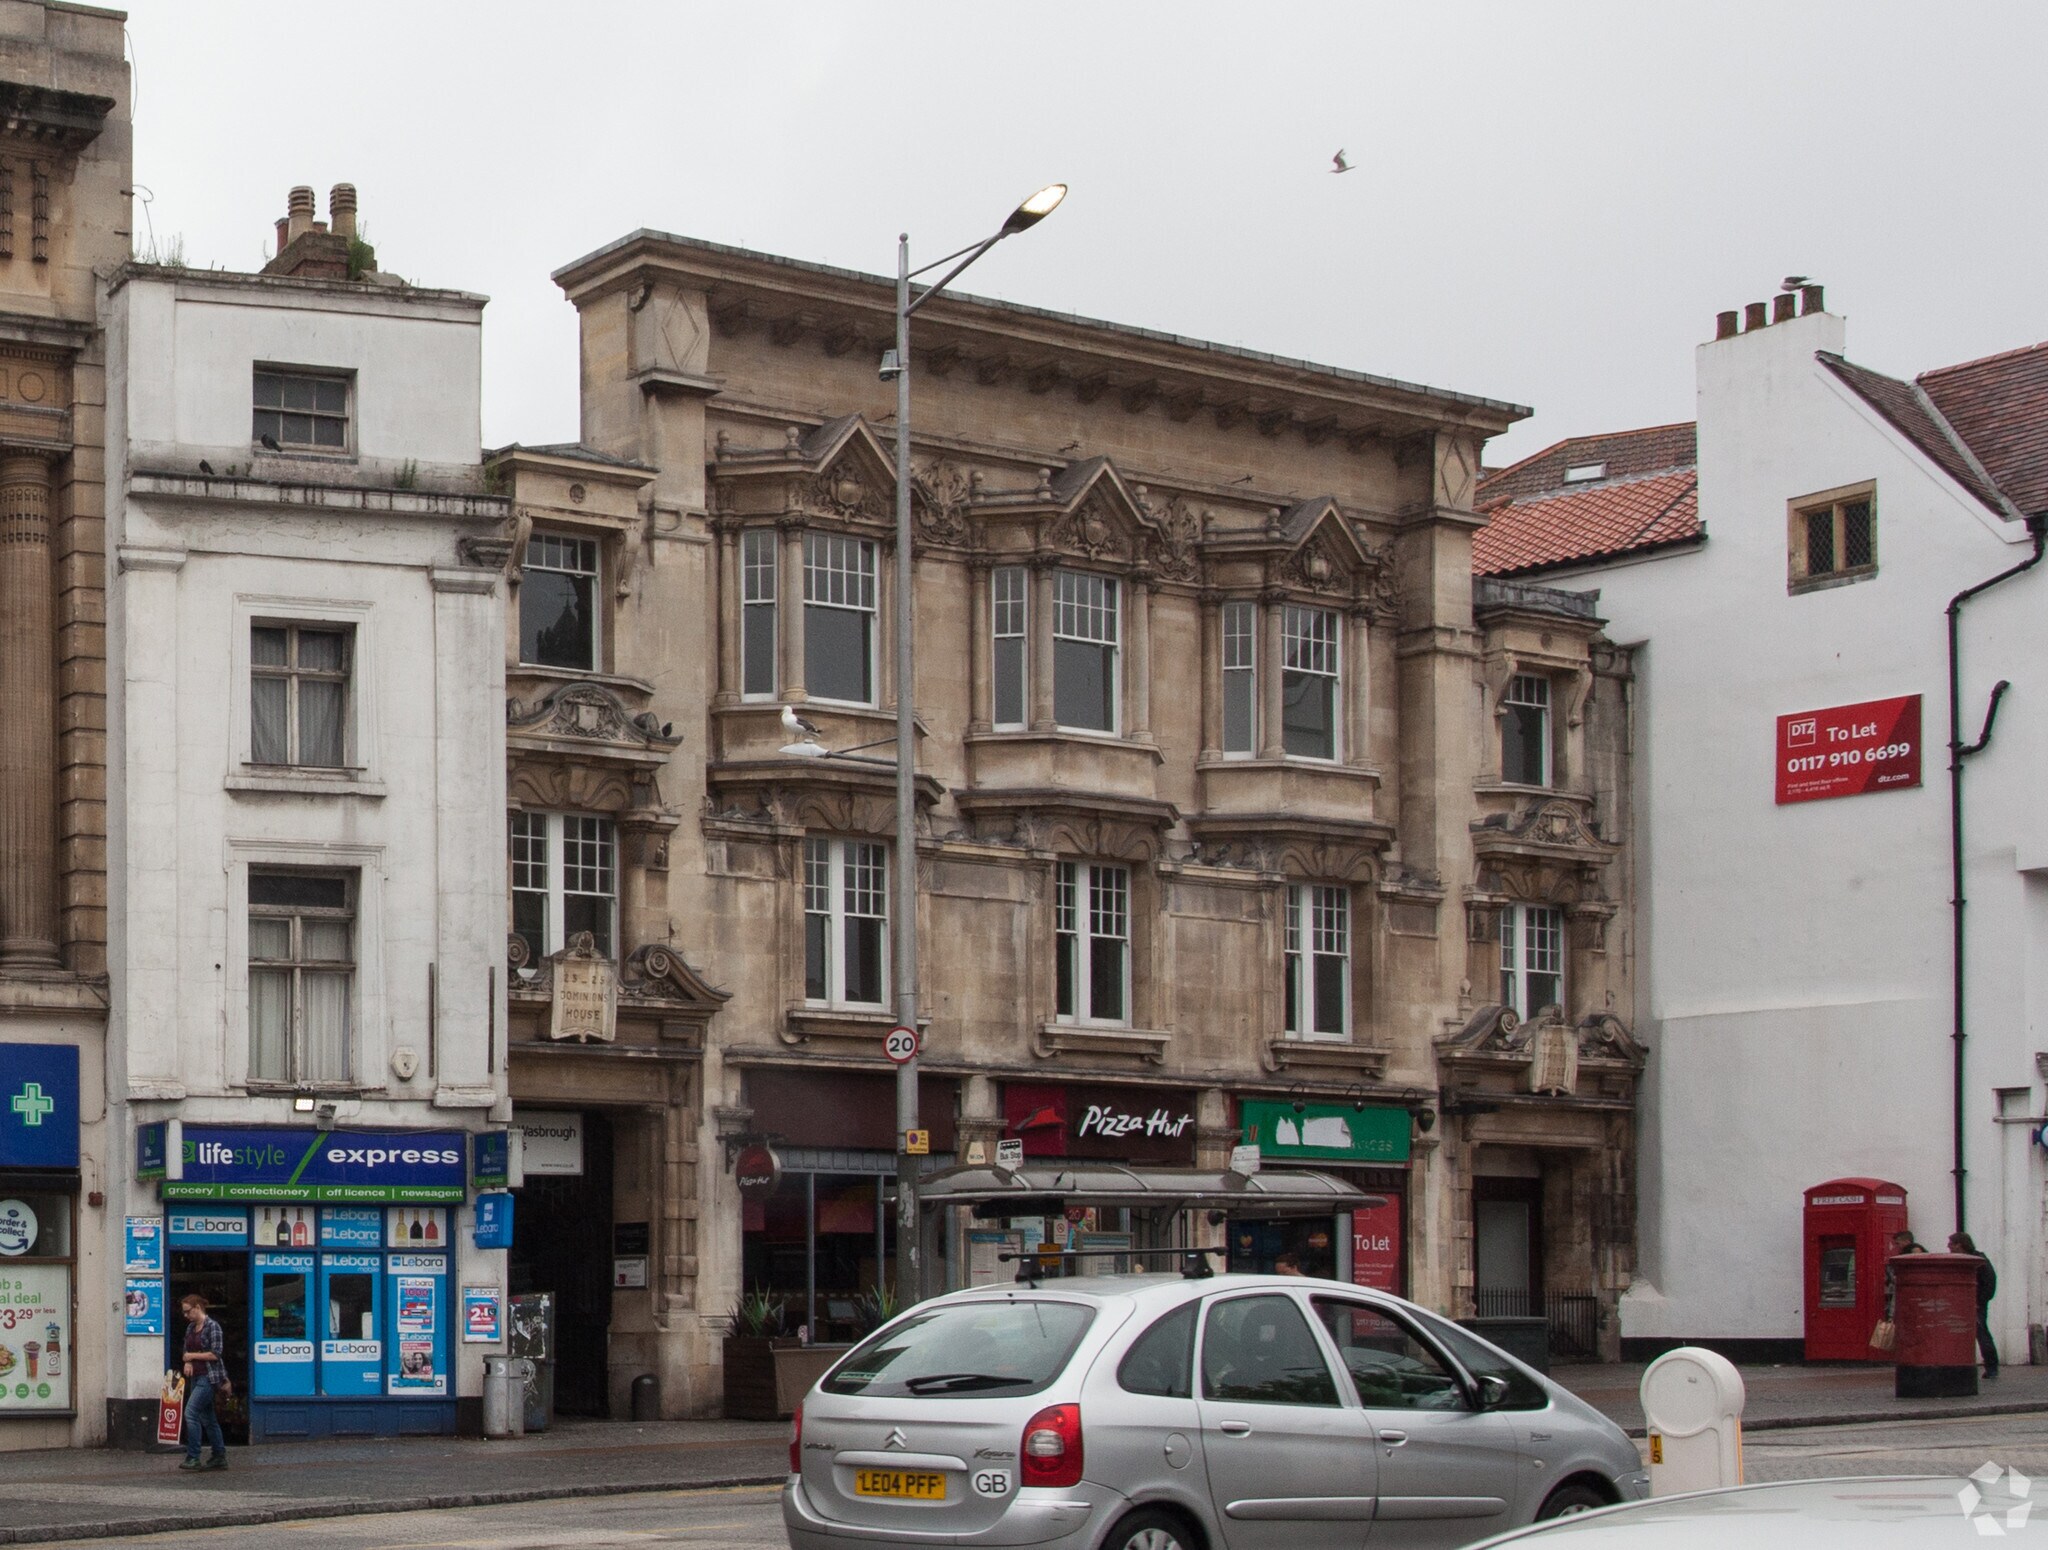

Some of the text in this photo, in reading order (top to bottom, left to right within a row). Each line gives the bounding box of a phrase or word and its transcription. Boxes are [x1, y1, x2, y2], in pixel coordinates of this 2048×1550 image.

[1792, 722, 1877, 742] DTZ To Let
[1787, 743, 1910, 772] 0117 910 6699
[1878, 774, 1909, 784] dtz.com
[566, 1008, 600, 1020] HOUSE
[890, 1037, 914, 1052] 20
[1080, 1105, 1194, 1137] Pizza Hut
[199, 1142, 460, 1169] lifestyle express
[168, 1187, 463, 1198] grocery confectionery off licence newsagent
[333, 1208, 379, 1220] Lebara
[187, 1218, 242, 1232] Lebara
[333, 1228, 379, 1240] Lebara
[1354, 1235, 1390, 1250] To Let
[267, 1254, 313, 1266] Lebara
[334, 1254, 379, 1266] Lebara
[402, 1256, 443, 1267] Lebara
[15, 1281, 22, 1290] a
[134, 1280, 162, 1288] Lebara
[14, 1293, 41, 1304] deal
[269, 1344, 310, 1355] Lebara
[336, 1344, 377, 1353] Lebara
[1652, 1436, 1659, 1448] T
[1653, 1451, 1660, 1463] 5
[862, 1473, 939, 1494] LE04 PFF
[976, 1474, 1007, 1493] GB
